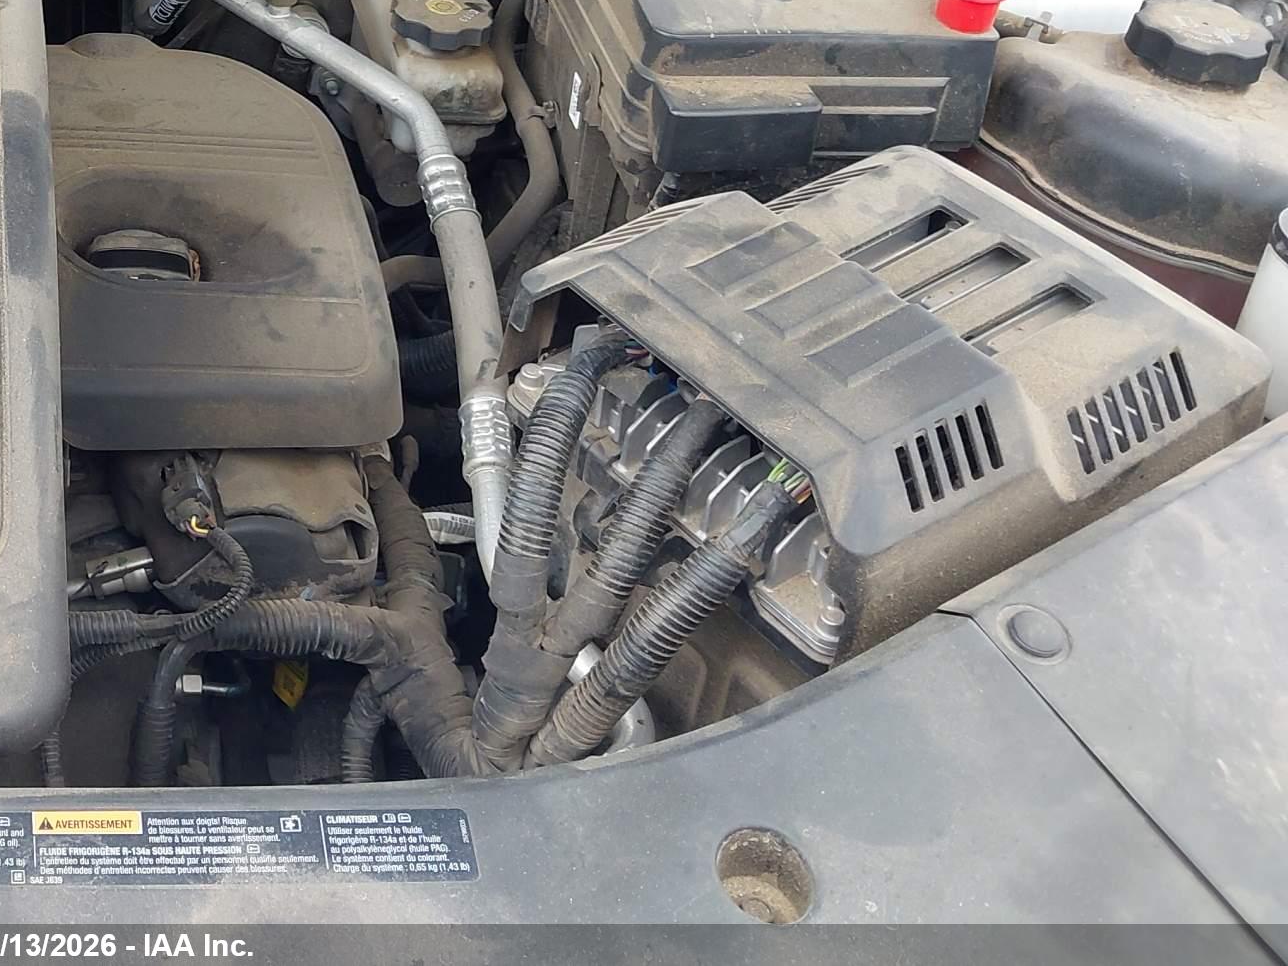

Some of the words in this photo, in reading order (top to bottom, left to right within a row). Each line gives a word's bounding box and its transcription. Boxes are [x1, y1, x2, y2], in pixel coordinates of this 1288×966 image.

[55, 819, 133, 829] AVERTISSEMENT
[147, 817, 180, 826] Attention
[196, 817, 220, 827] doigts!
[222, 817, 247, 826] Risque
[326, 815, 378, 824] CLIMATISEUR
[10, 829, 24, 837] and
[148, 826, 157, 834] de
[159, 826, 195, 834] blessures.
[197, 826, 206, 834] Le
[208, 826, 246, 834] ventilateur
[248, 826, 264, 834] peut
[328, 827, 352, 835] Utiliser
[354, 826, 392, 835] seulement
[394, 826, 401, 834] le
[403, 826, 423, 834] fluide
[228, 834, 280, 842] avertissement.
[329, 836, 368, 845] frigorigène
[408, 835, 417, 843] de
[39, 847, 67, 856] FLUIDE
[122, 847, 150, 855] R-134a
[152, 847, 173, 855] SOUS
[175, 847, 201, 855] HAUTE
[203, 846, 242, 855] PRESSION
[409, 845, 429, 853] (huile
[15, 858, 25, 867] lb)
[80, 857, 89, 865] du
[91, 857, 122, 866] système
[123, 857, 137, 865] doit
[139, 856, 154, 865] être
[187, 857, 199, 865] par
[212, 856, 248, 864] personnel
[332, 855, 341, 863] Le
[343, 854, 374, 864] système
[375, 854, 405, 862] contient
[406, 853, 416, 861] du
[418, 853, 450, 861] colorant.
[40, 867, 54, 875] Des
[56, 866, 92, 875] méthodes
[178, 867, 207, 876] peuvent
[235, 865, 248, 873] des
[334, 864, 359, 874] Charge
[361, 864, 371, 872] du
[409, 863, 427, 872] 0,65
[429, 863, 438, 872] kg
[439, 862, 458, 872] (1,43
[460, 862, 470, 872] lb)
[30, 876, 45, 884] SAE
